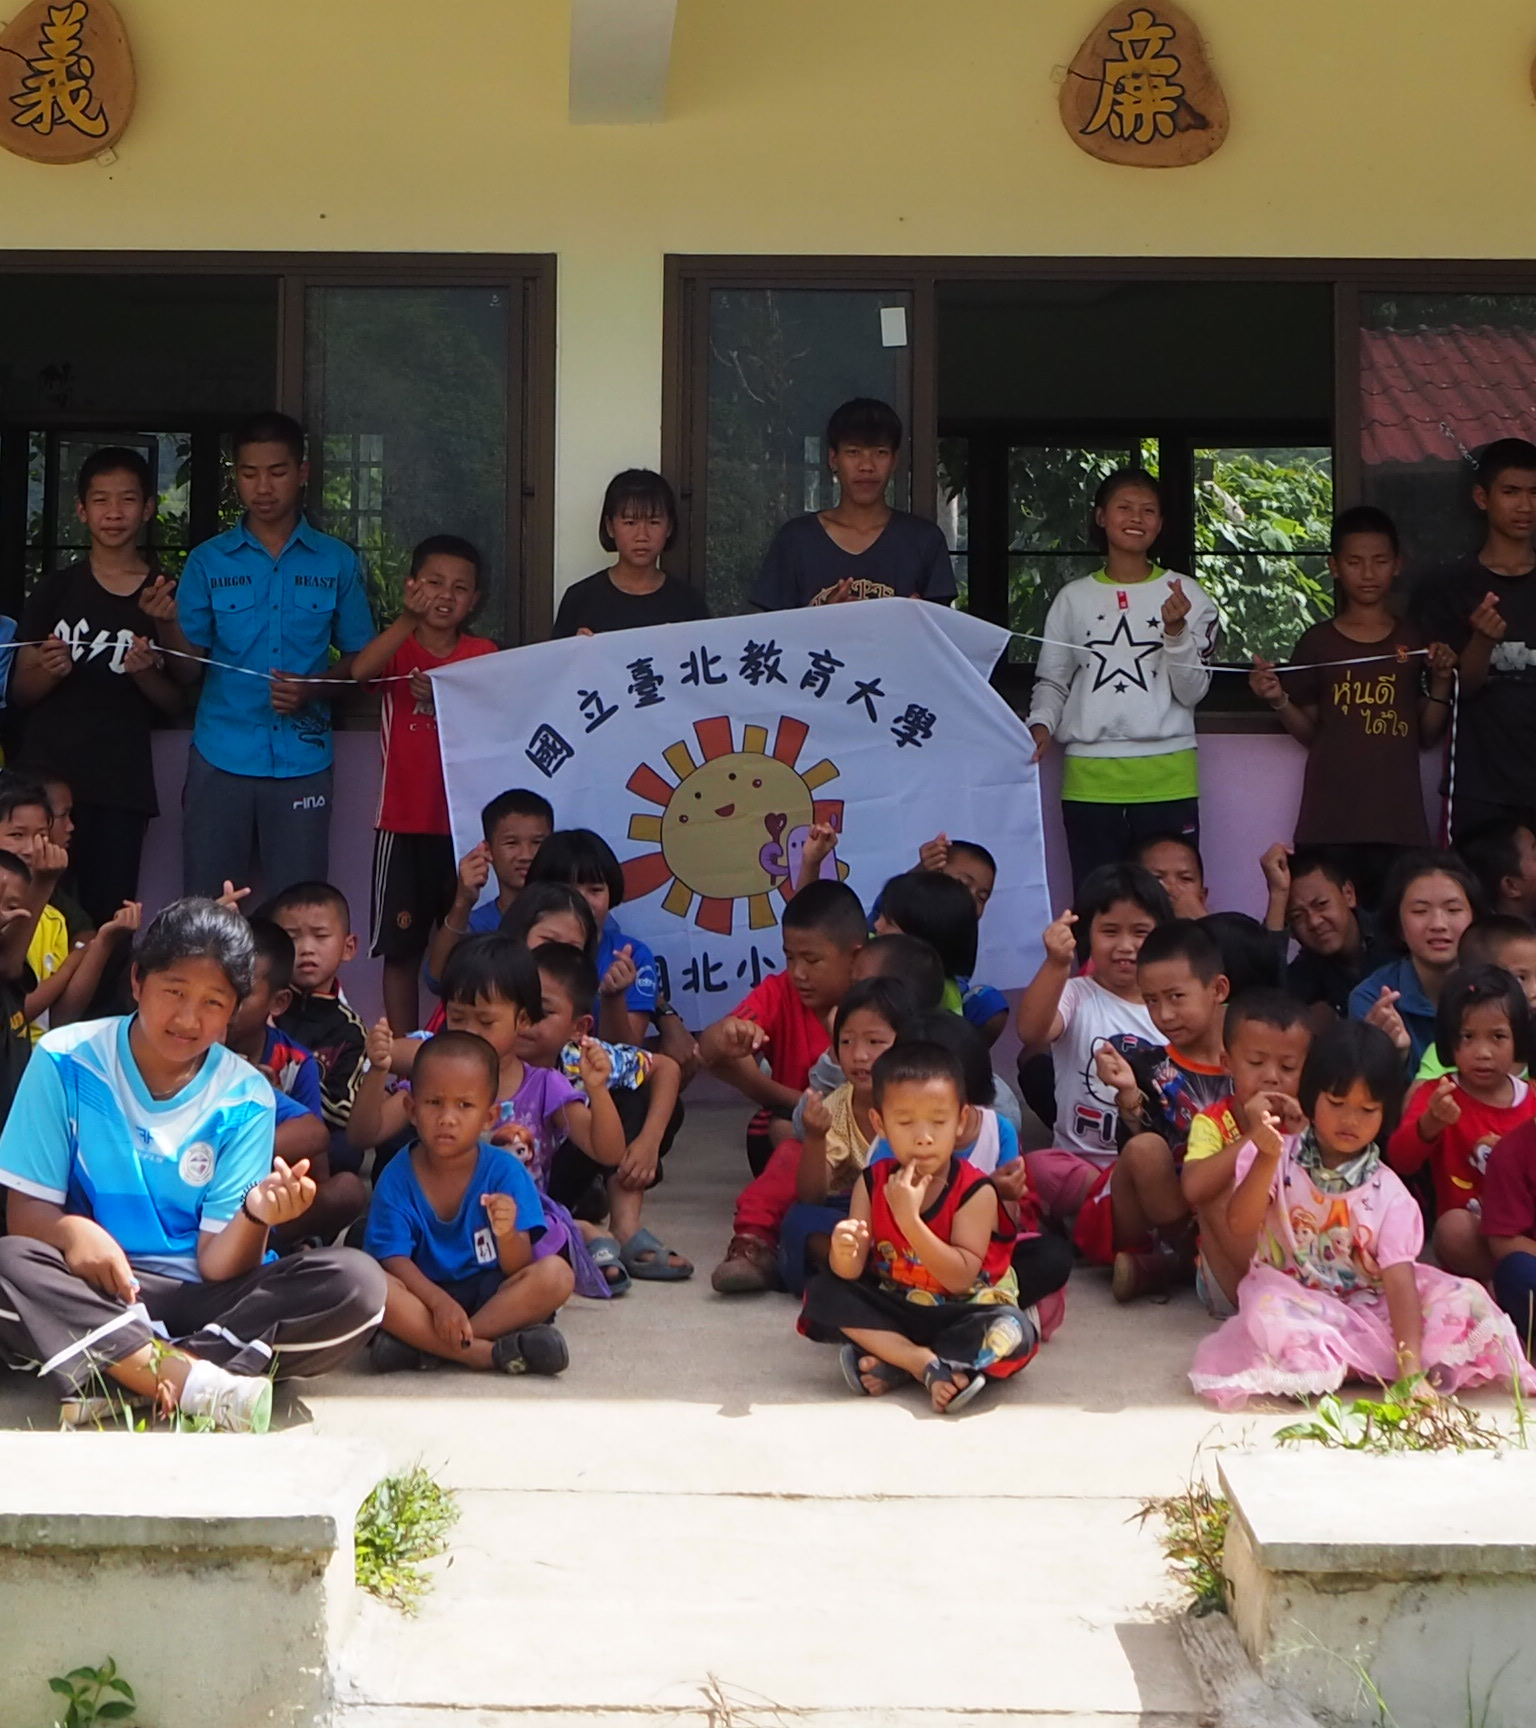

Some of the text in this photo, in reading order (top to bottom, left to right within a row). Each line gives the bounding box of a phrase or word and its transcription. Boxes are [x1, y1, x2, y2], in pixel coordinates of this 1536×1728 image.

[9, 0, 109, 137] 義
[210, 575, 337, 589] DARGON BEAST
[525, 639, 938, 777] 國立臺北教育大學
[1333, 670, 1396, 715] หุ่นดี
[1360, 709, 1409, 737] ได้ใจ
